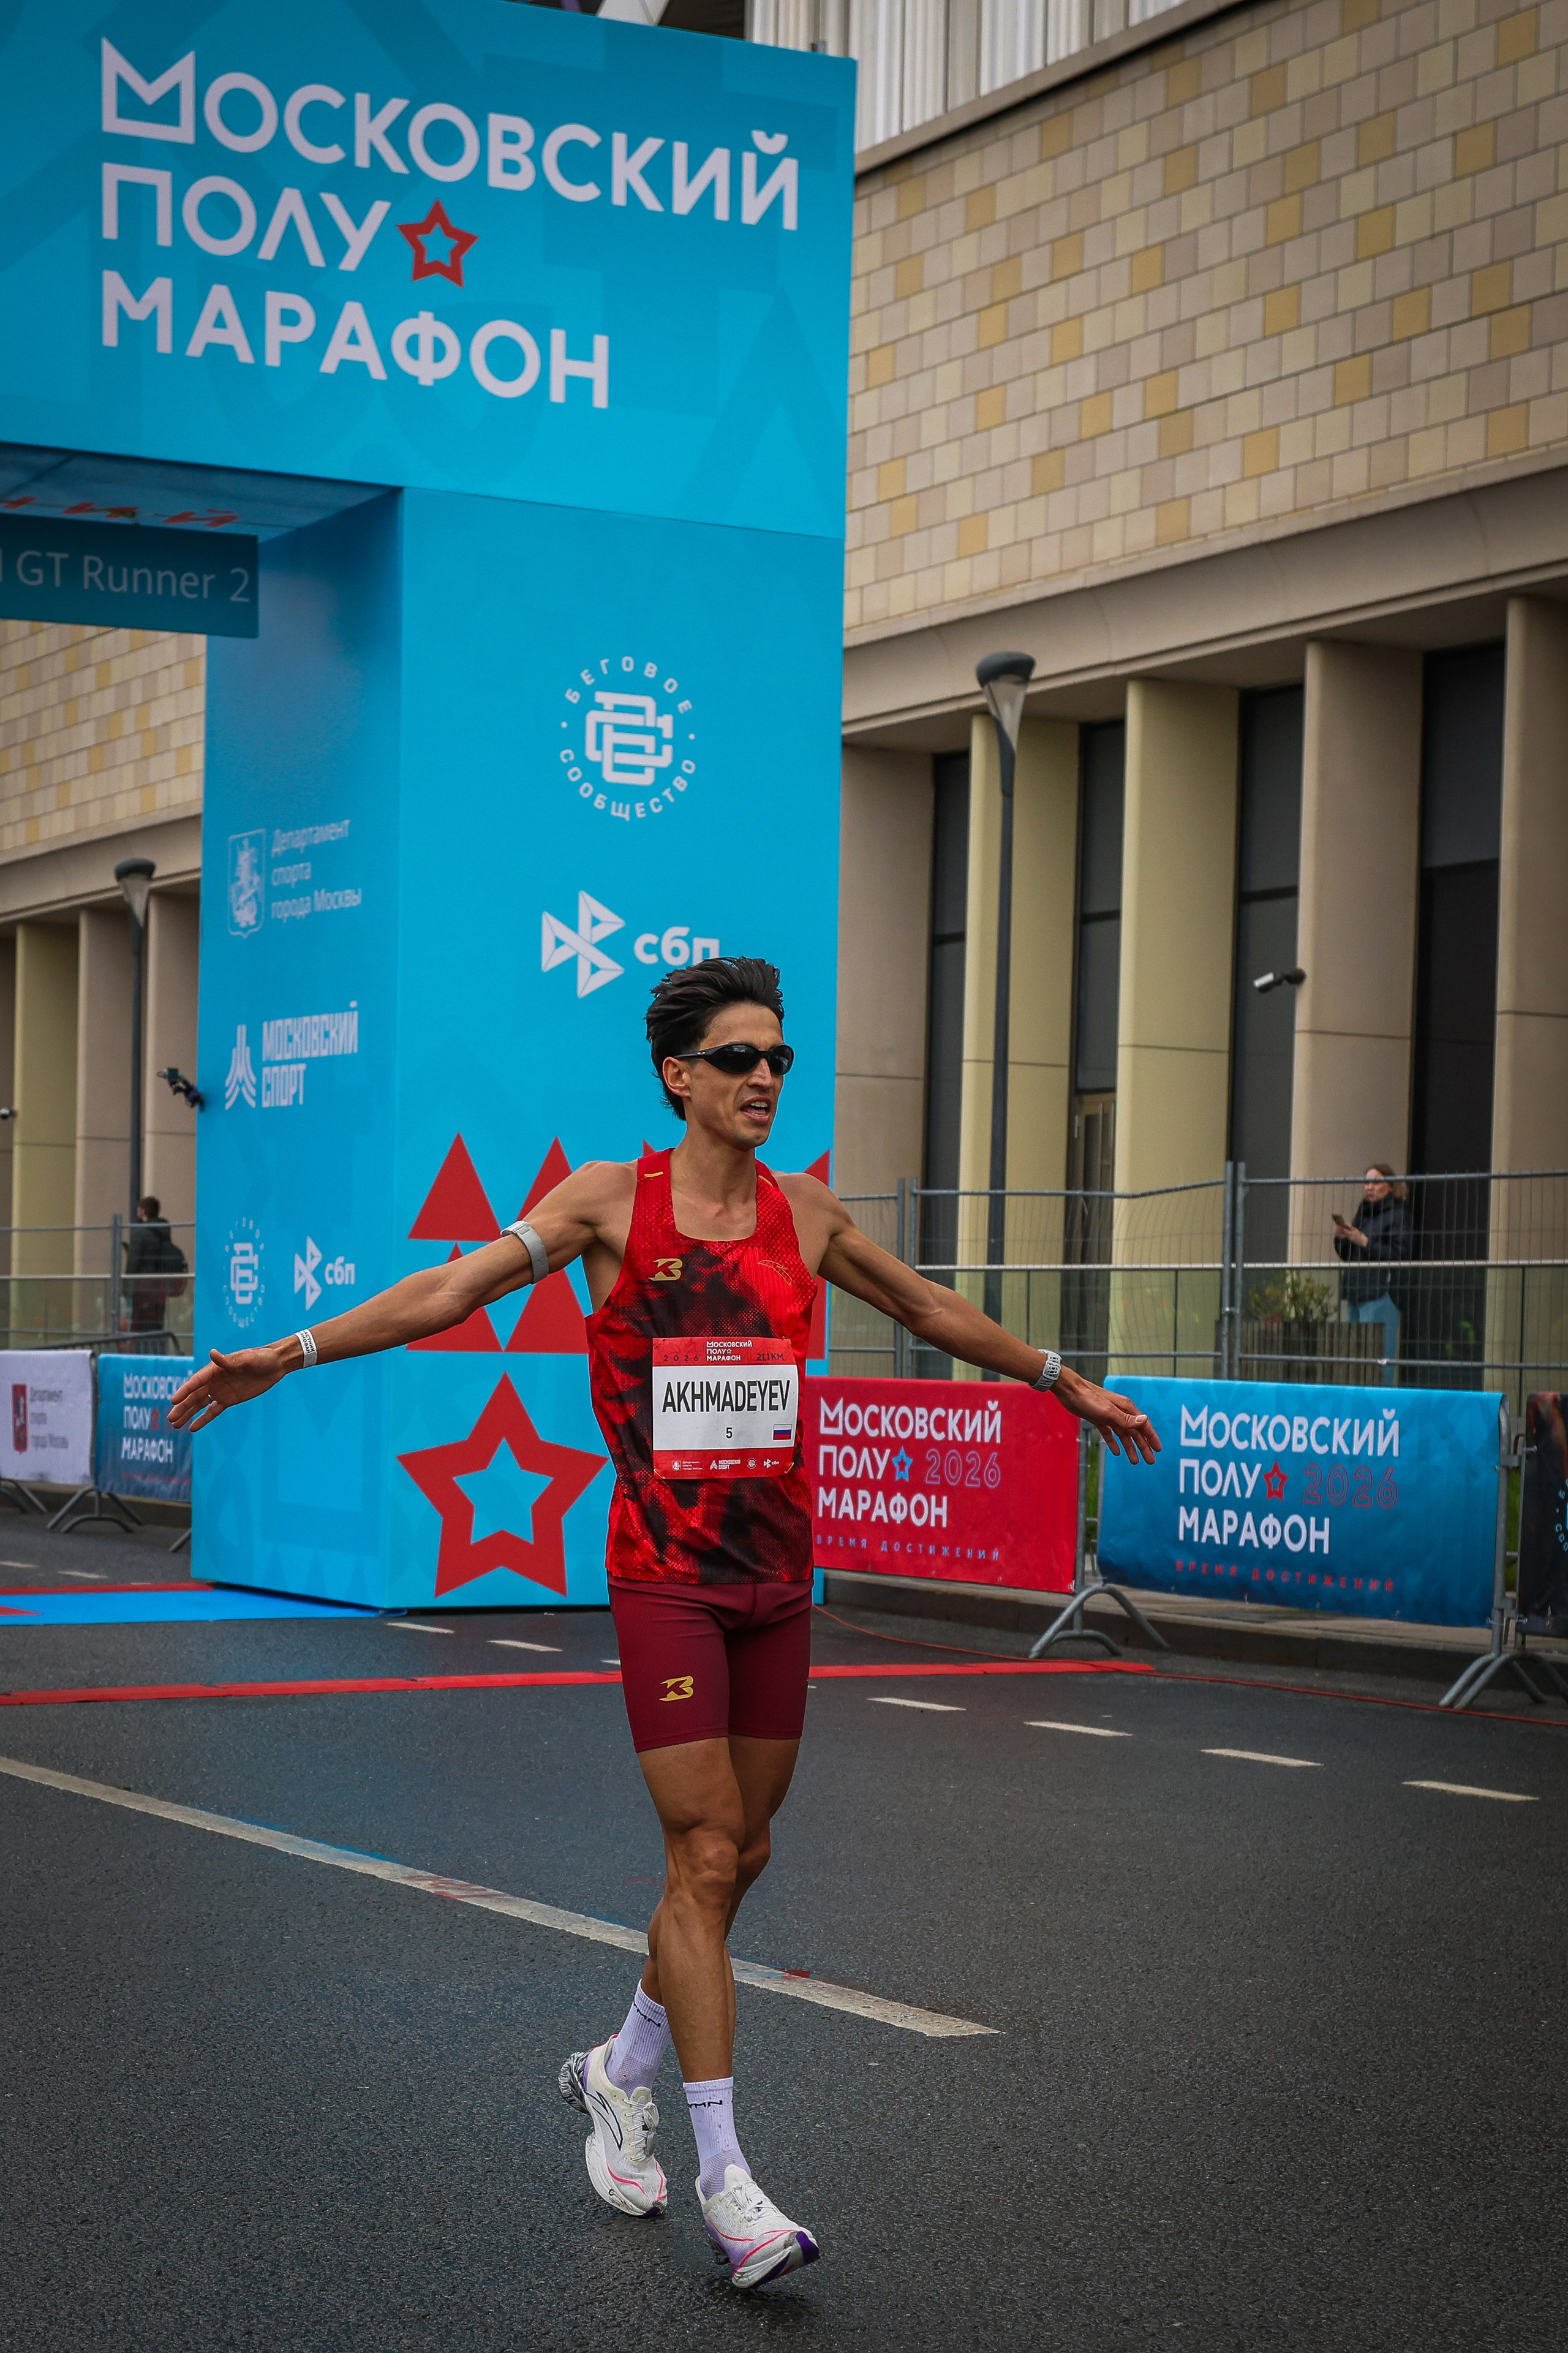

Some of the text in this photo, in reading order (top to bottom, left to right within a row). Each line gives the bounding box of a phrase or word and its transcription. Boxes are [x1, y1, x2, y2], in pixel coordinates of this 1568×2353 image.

[102, 37, 798, 230] МОСКОВСКИЙ
[102, 162, 391, 271] ПОЛУ
[102, 270, 609, 409] МАРАФОН
[17, 550, 69, 587] GT
[83, 555, 216, 599] Runner
[230, 568, 249, 602] 2
[564, 655, 693, 714] БЕГОВОЕ
[559, 749, 696, 821] СООБЩЕСТВО
[262, 1000, 358, 1061] МОСКОВСКИЙ
[262, 1063, 307, 1108] СПОРТ
[325, 1256, 355, 1285] сбп
[304, 1331, 315, 1353] АСТНИК
[124, 1405, 151, 1430] ПОЛУ
[662, 1380, 790, 1413] AKHMADEYEV
[726, 1427, 733, 1439] 5
[820, 1397, 1002, 1444] МОСКОВСКИЙ
[1180, 1404, 1400, 1457] МОСКОВСКИЙ
[121, 1437, 173, 1463] МАРАФОН
[819, 1445, 1001, 1489] ПОЛУ 2026
[1180, 1459, 1399, 1509] ПОЛУ 2026
[818, 1487, 948, 1528] МАРАФОН
[1179, 1506, 1330, 1554] МАРАФОН
[816, 1535, 999, 1560] ВРЕМЯ ДОСТИЖЕНИЙ
[1176, 1560, 1393, 1592] ВРЕМЯ ДОСТИЖЕНИЙ
